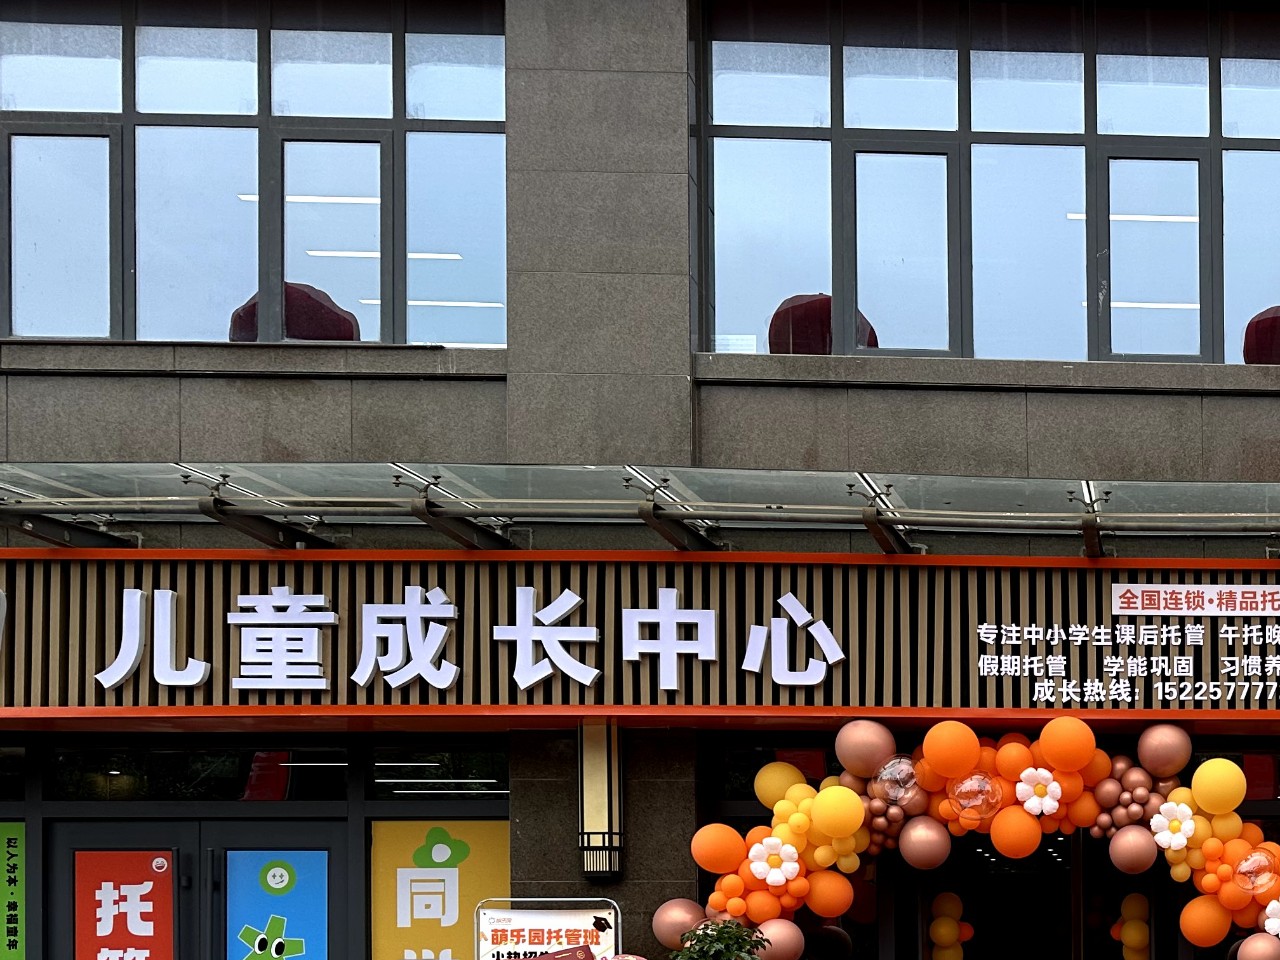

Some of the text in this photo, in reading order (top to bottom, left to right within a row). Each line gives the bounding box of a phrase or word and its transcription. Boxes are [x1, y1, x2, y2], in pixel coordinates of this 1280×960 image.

[93, 586, 846, 691] 儿童成长中心
[976, 622, 1205, 646] 专注中小学生课后托管
[977, 654, 1067, 677] 假期托管
[1103, 655, 1194, 677] 学能巩固
[491, 928, 600, 945] 萌乐园托管班
